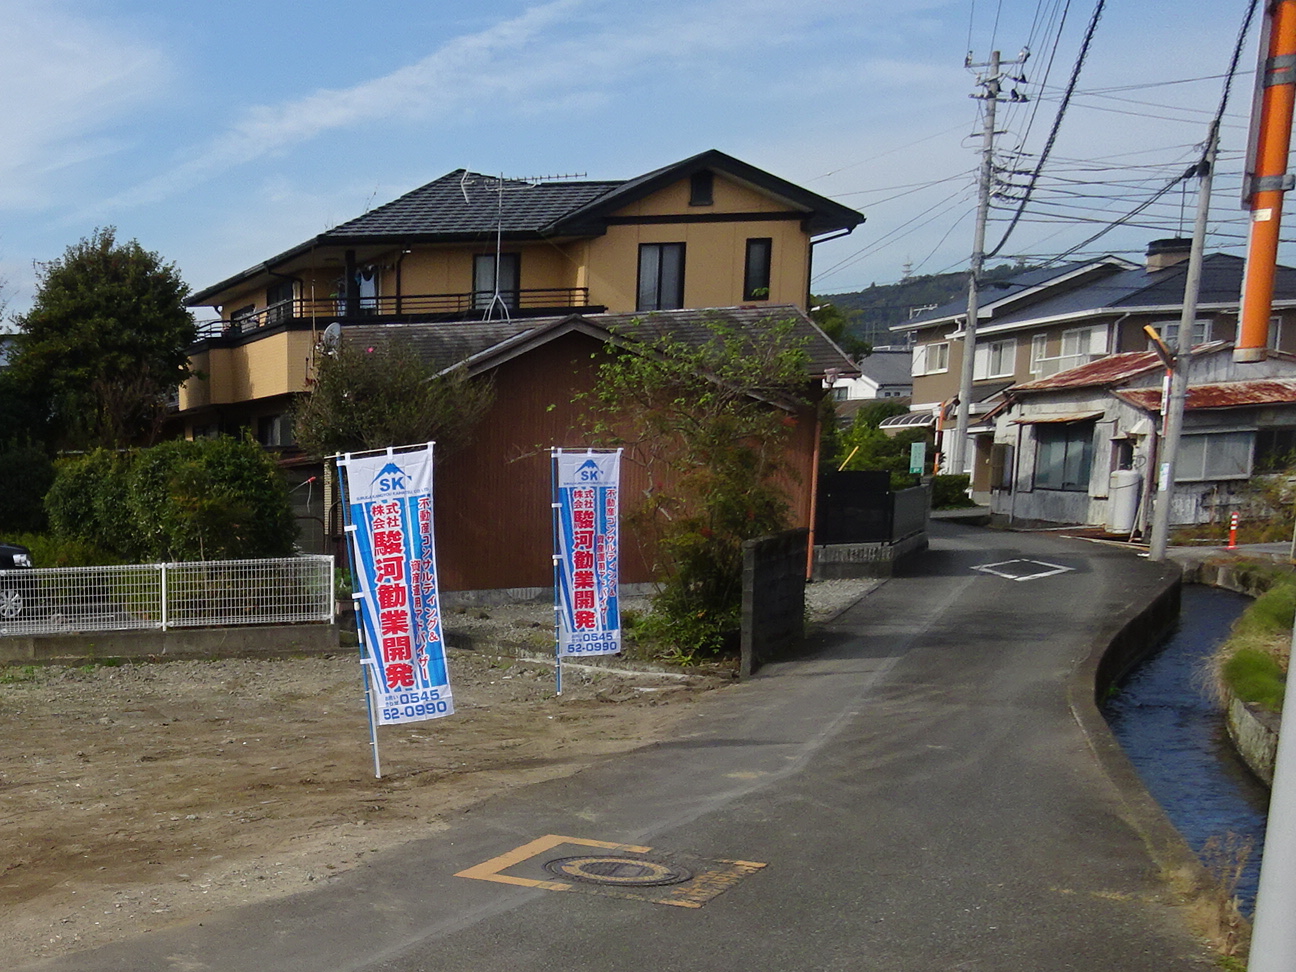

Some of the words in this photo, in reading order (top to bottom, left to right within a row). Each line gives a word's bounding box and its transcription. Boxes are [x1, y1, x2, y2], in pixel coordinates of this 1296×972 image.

[581, 470, 598, 481] SK
[379, 476, 405, 492] SK
[573, 510, 596, 630] 駿河勧業開発
[373, 530, 415, 689] 駿河勧業開発
[582, 632, 613, 642] 0545
[567, 641, 618, 653] 52-0990
[399, 689, 440, 705] 0545
[383, 701, 447, 720] 52-0990
